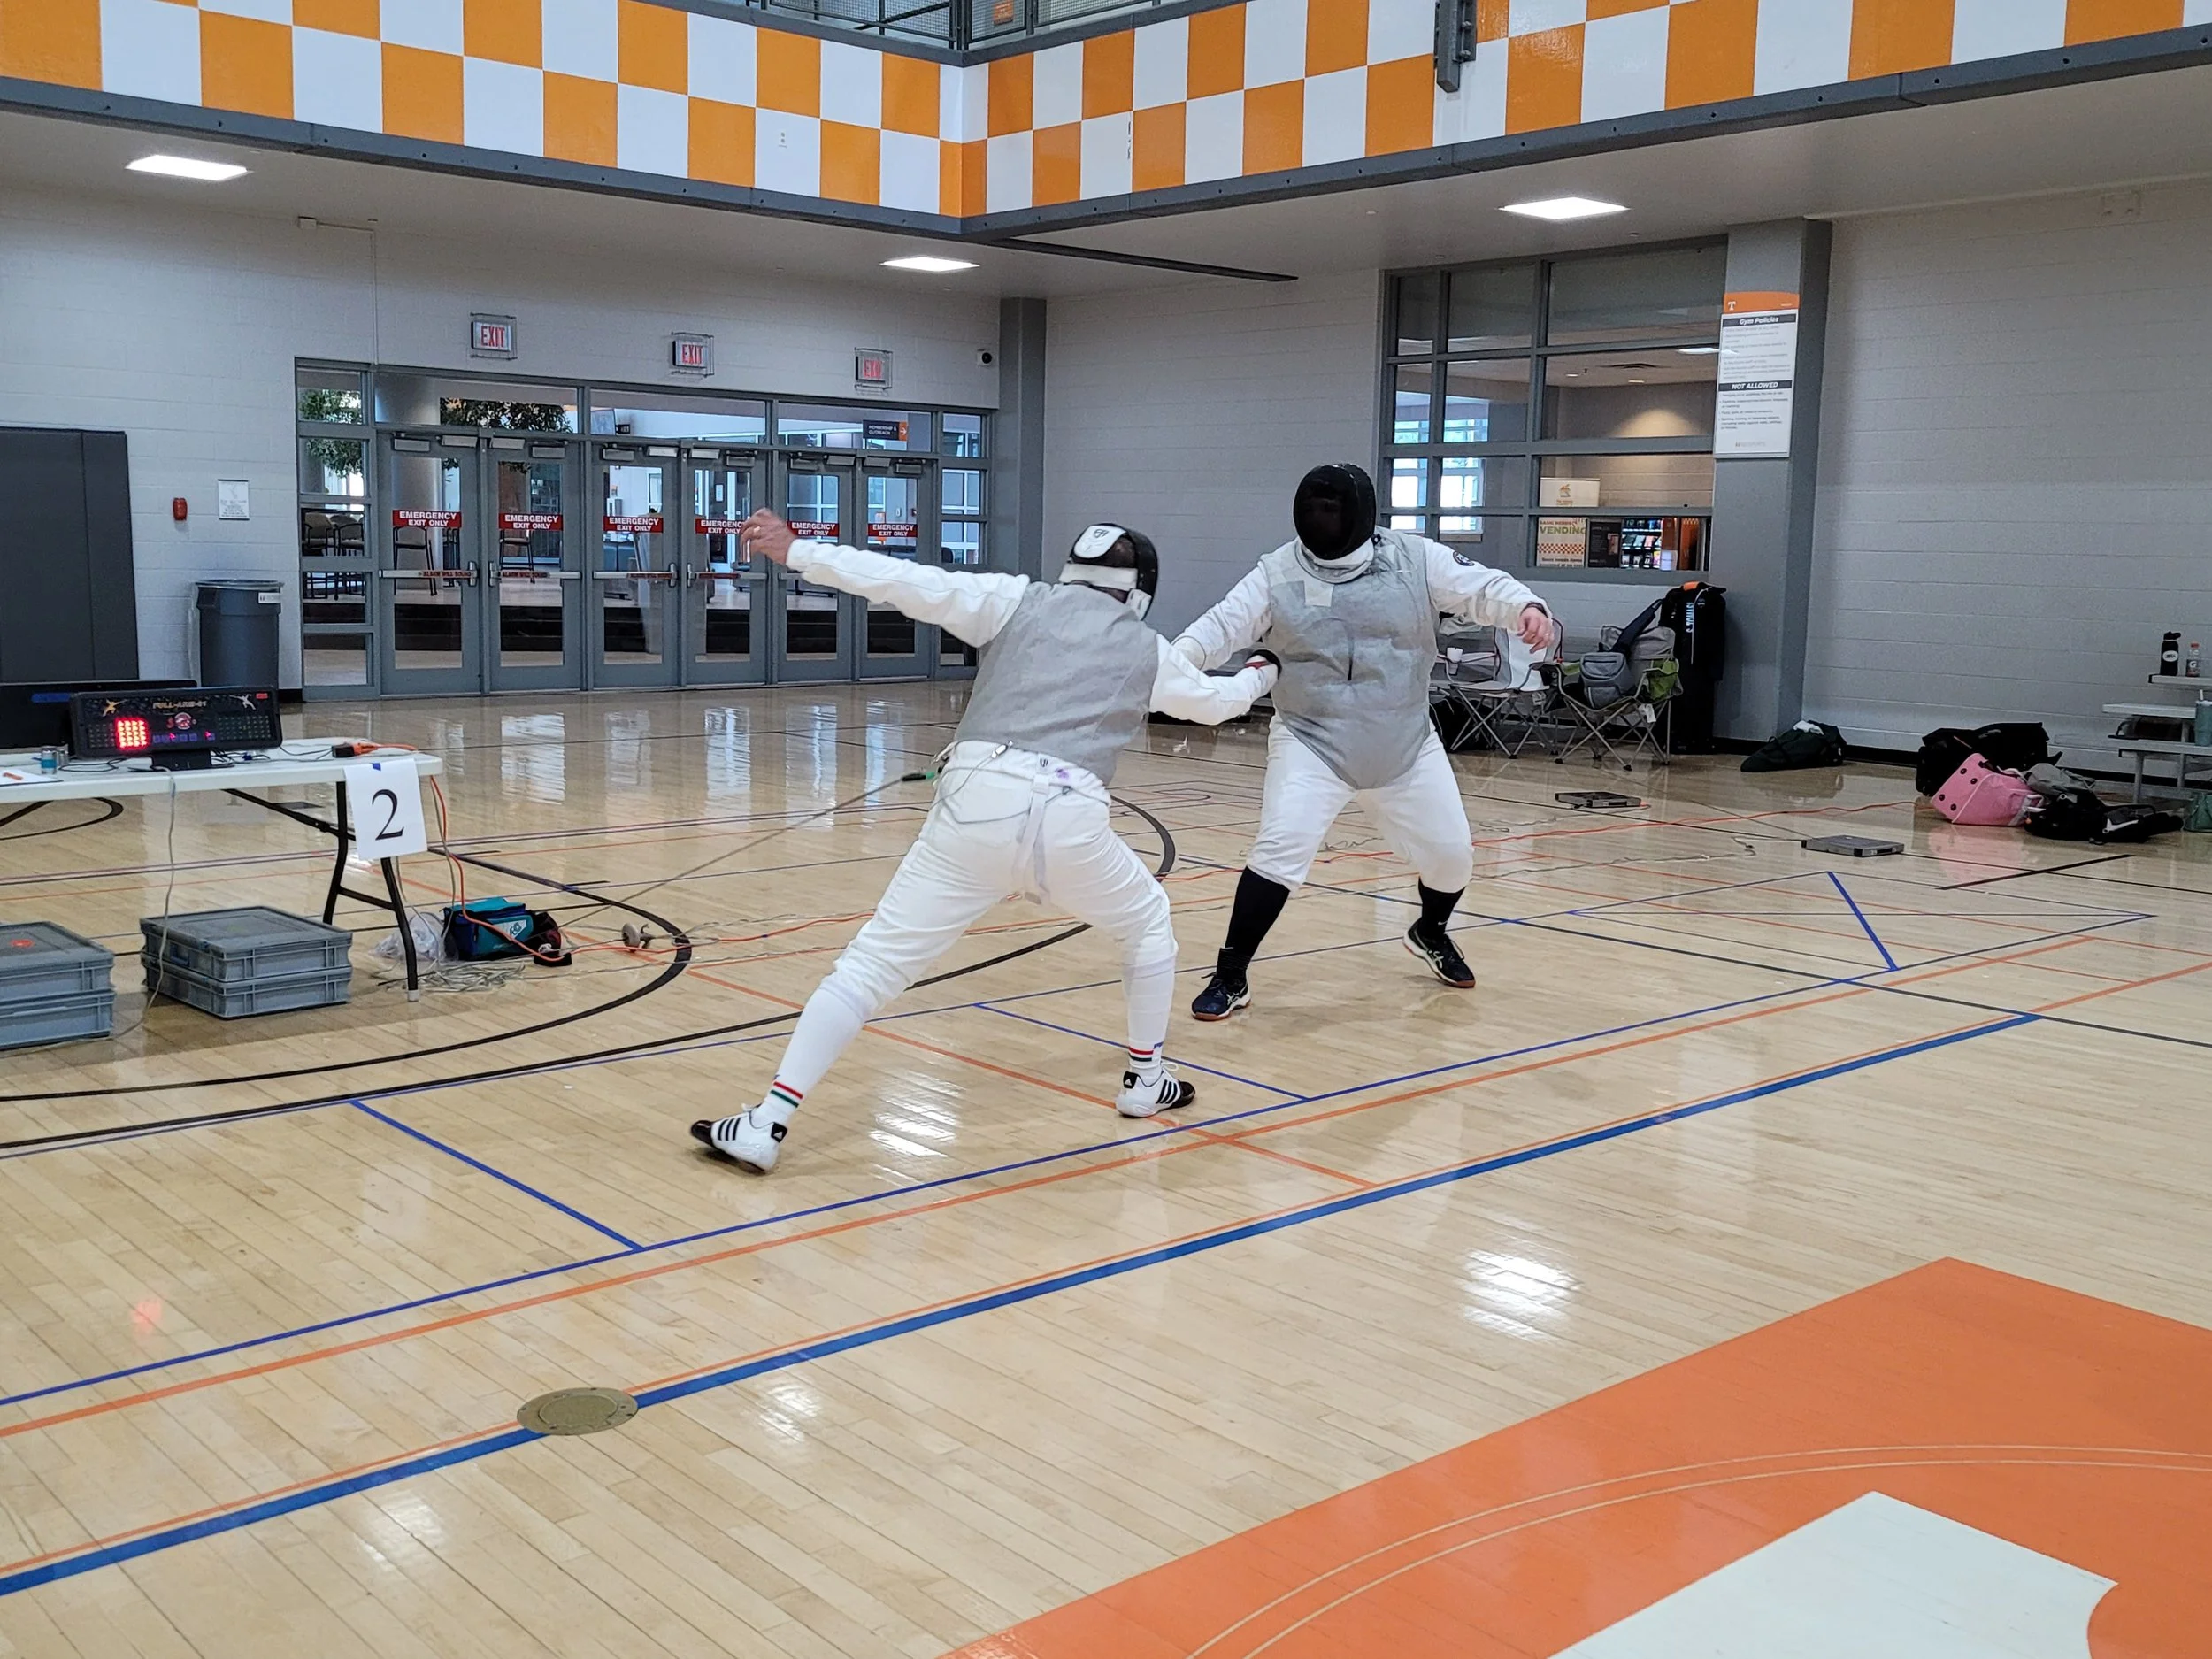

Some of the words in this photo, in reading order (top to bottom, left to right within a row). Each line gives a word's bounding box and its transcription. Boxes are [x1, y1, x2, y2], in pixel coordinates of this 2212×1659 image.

[480, 326, 505, 348] EXIT
[682, 344, 703, 364] EXIT
[399, 511, 457, 520] EMERGENCY
[504, 514, 558, 523] EMERGENCY
[609, 517, 659, 526] EMERGENCY
[700, 519, 744, 528] EMERGENC
[791, 522, 835, 531] EMERGENCY
[371, 788, 404, 841] 2
